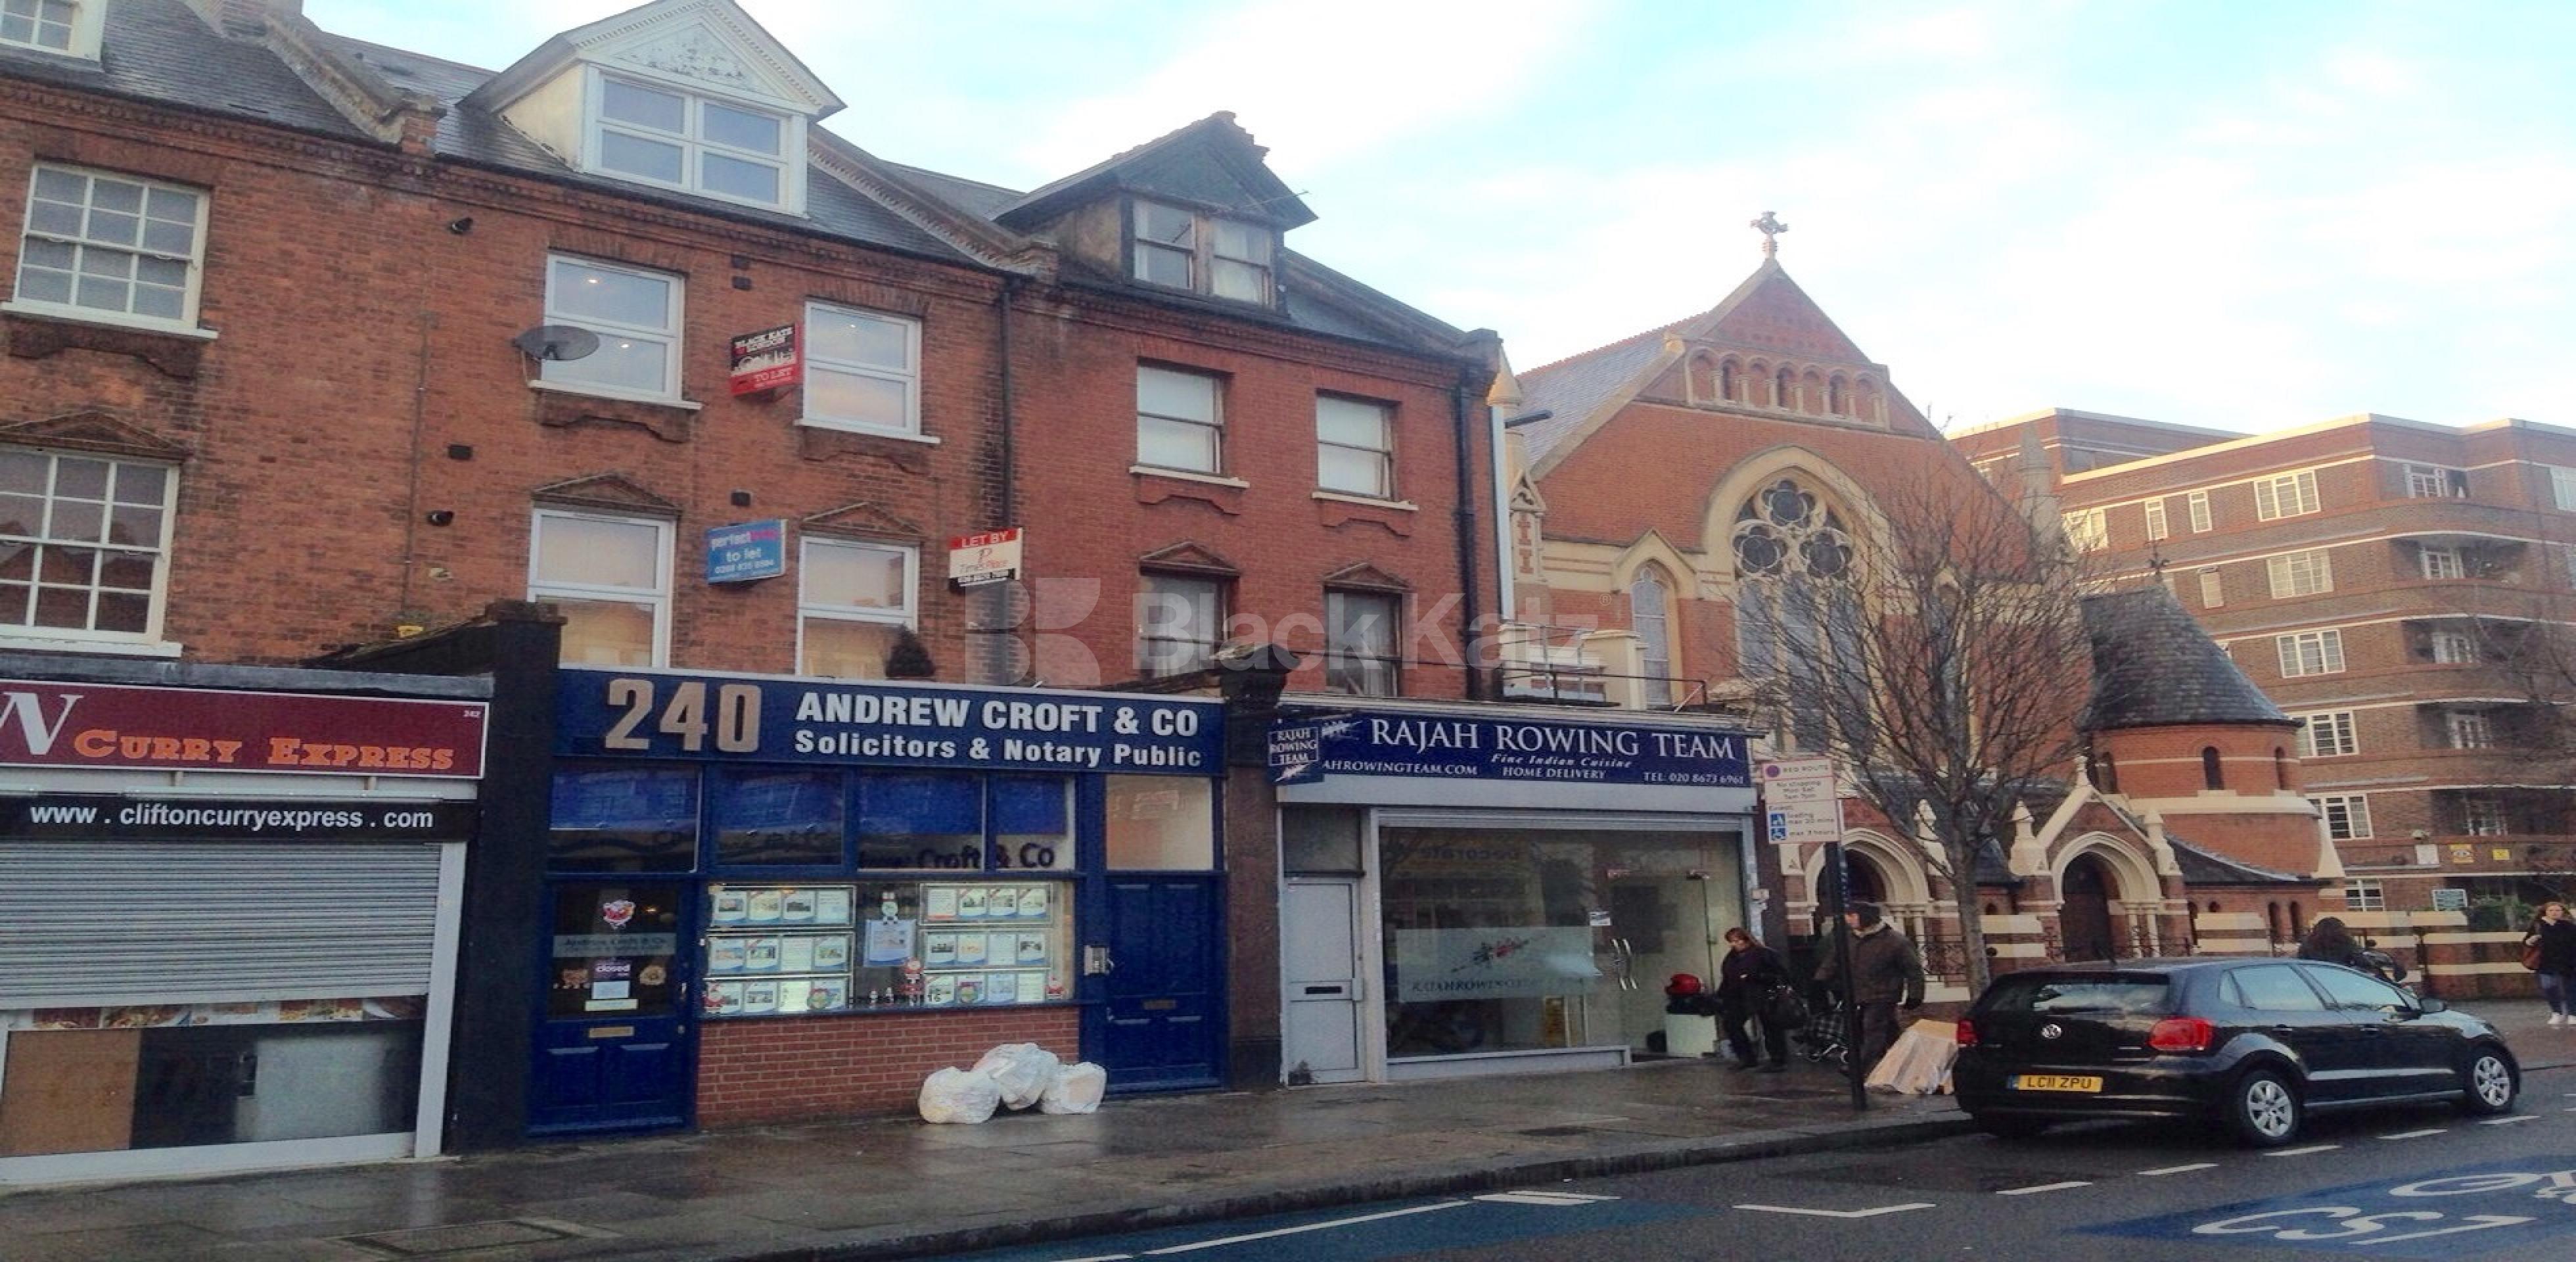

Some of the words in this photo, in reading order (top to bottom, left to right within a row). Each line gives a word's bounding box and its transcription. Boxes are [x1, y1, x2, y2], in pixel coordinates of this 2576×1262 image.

[961, 534, 987, 548] LET
[990, 531, 1009, 544] BY
[726, 551, 741, 563] to
[745, 547, 761, 559] let
[605, 678, 762, 753] 240
[796, 692, 970, 729] ANDREW
[982, 701, 1102, 732] CROFT
[1113, 707, 1139, 734] &
[1152, 709, 1198, 737] CO
[1277, 728, 1311, 740] RAJAH
[1371, 719, 1479, 754] RAJAH
[1496, 725, 1640, 755] ROWING
[1651, 733, 1736, 759] TEAM
[74, 729, 242, 763] CURRY
[267, 737, 454, 770] EXPRESS
[795, 729, 955, 759] Solicitors
[969, 737, 990, 759] &
[1003, 739, 1101, 768] Notary
[1114, 744, 1202, 766] Public
[1280, 753, 1308, 764] TEAM
[1491, 754, 1523, 763] Fine
[1529, 755, 1575, 766] Indian
[1581, 757, 1632, 768] Cuisine
[1503, 767, 1542, 778] HOME
[1547, 768, 1607, 779] DELIVERY
[1670, 773, 1688, 783] 020
[31, 806, 97, 824] www
[120, 803, 363, 831] cliftoncurryexpress
[384, 809, 433, 828] com
[1019, 843, 1054, 868] Co
[2027, 1077, 2056, 1088] LC11
[2060, 1077, 2092, 1089] ZPU
